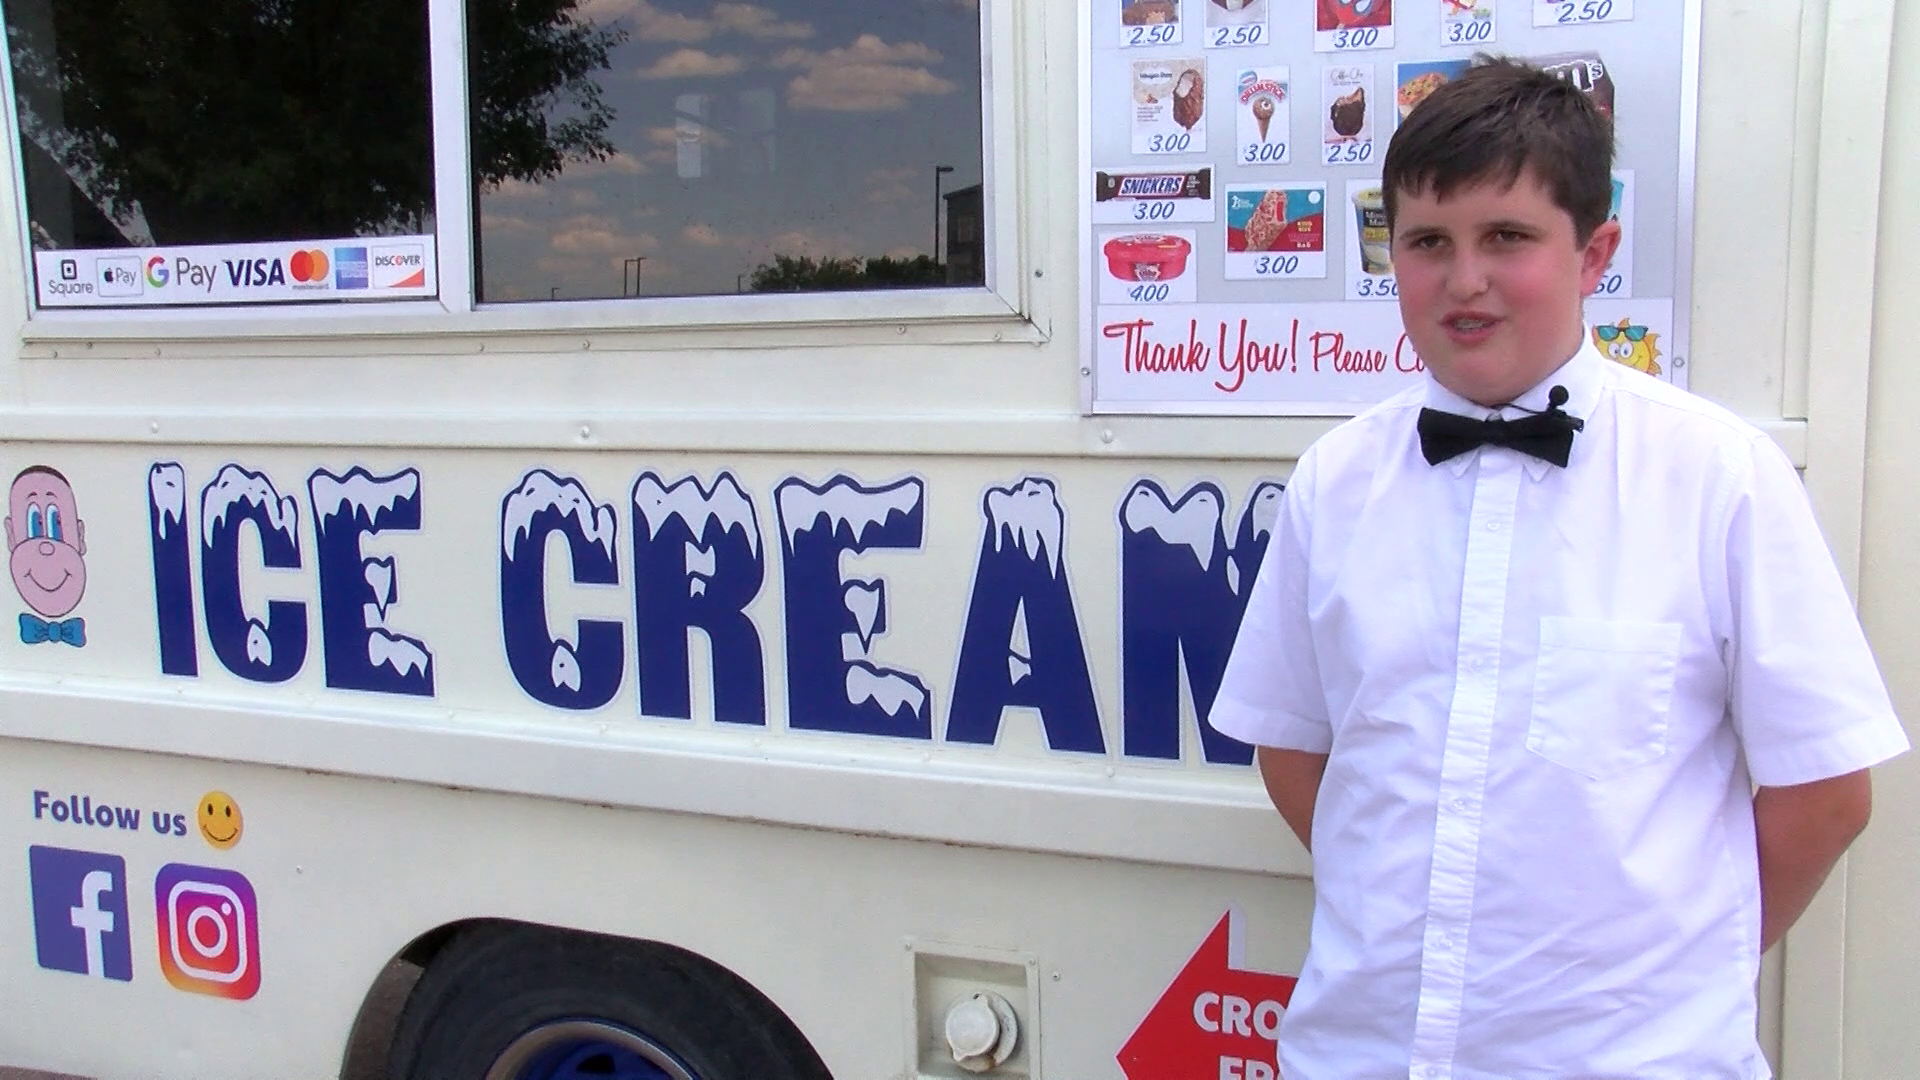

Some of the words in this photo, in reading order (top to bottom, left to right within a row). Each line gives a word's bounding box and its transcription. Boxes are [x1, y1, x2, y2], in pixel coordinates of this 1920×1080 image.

[1121, 176, 1183, 195] SNICKERS
[222, 258, 286, 287] VISA
[375, 254, 421, 267] DISCOVER
[48, 279, 94, 297] Square
[115, 266, 137, 288] Pay
[175, 257, 217, 294] Pay
[1103, 318, 1211, 373] Thank
[1214, 318, 1299, 393] You!
[1309, 331, 1388, 373] Please
[148, 461, 436, 698] ICE
[33, 789, 141, 831] Follow
[152, 810, 188, 837] us
